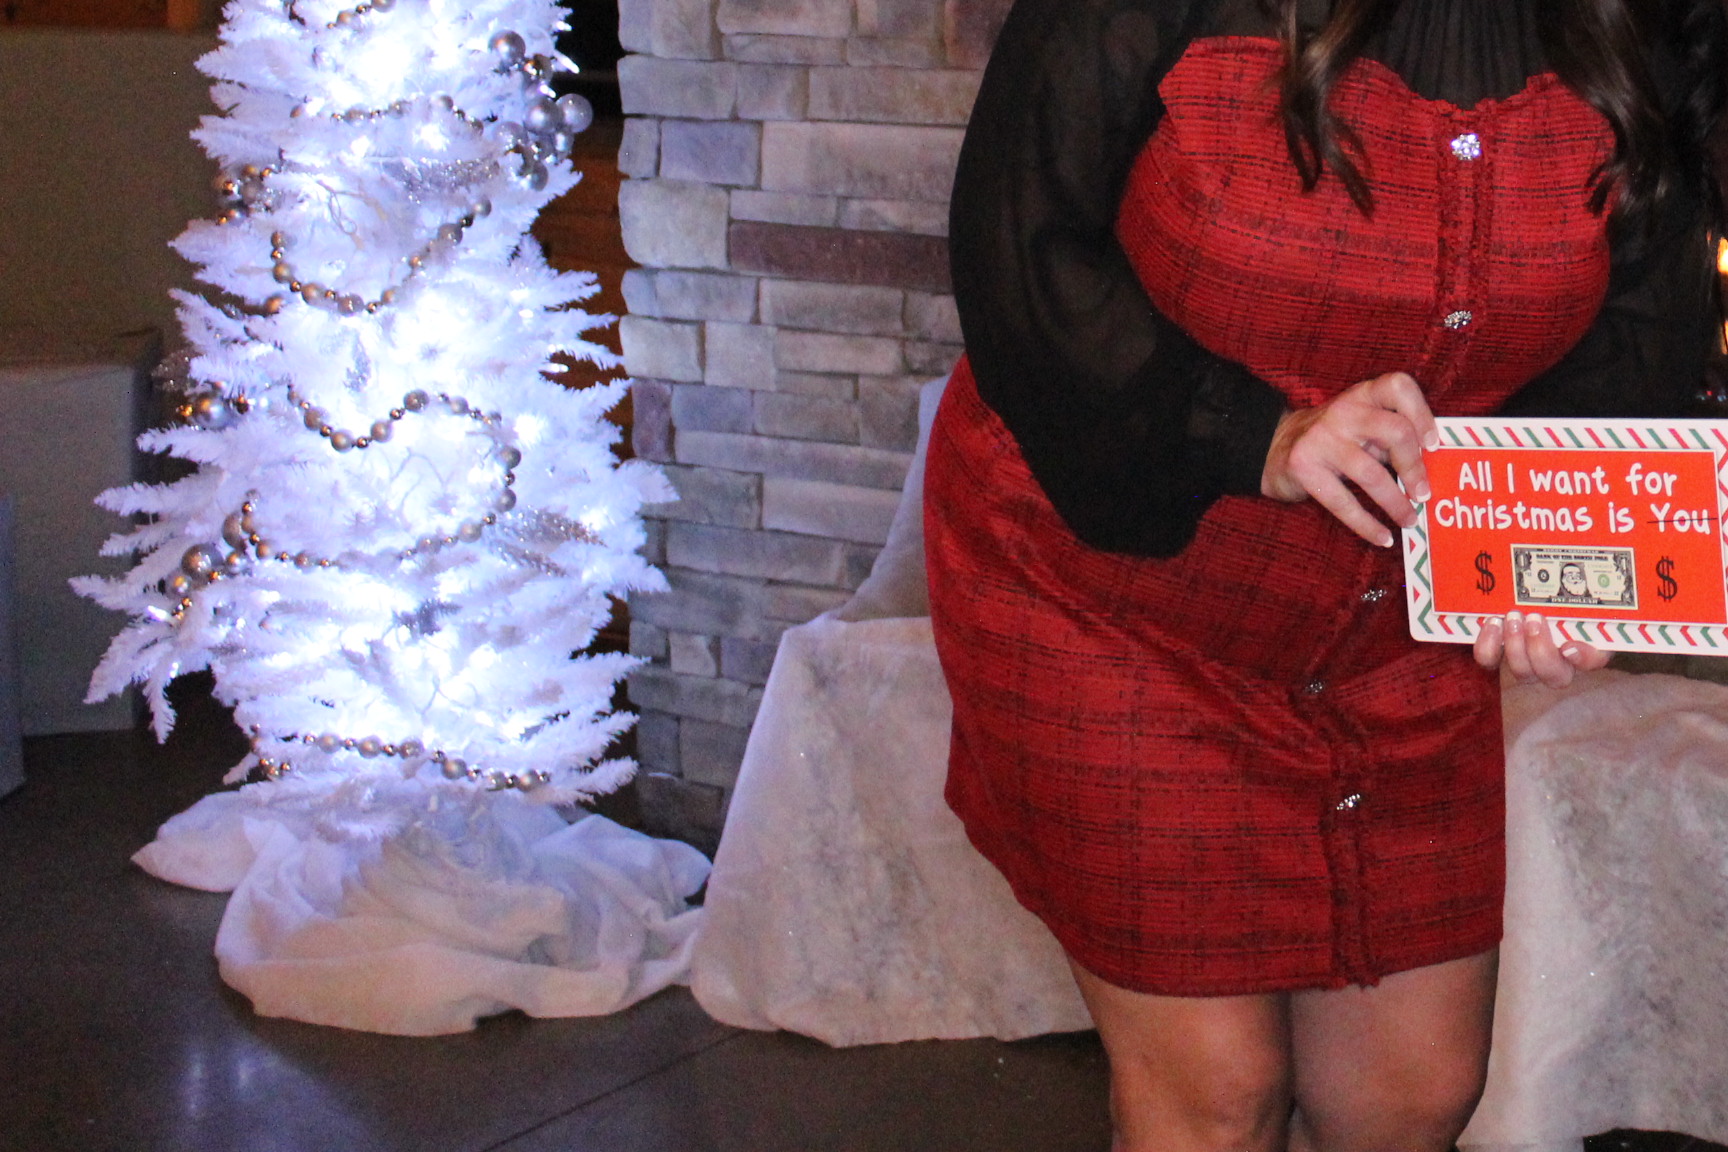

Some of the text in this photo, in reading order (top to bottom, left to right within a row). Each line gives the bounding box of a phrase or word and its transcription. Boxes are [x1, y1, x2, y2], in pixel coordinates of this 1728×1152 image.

[1458, 460, 1678, 497] All I want for
[1434, 495, 1711, 535] Christmas is You
